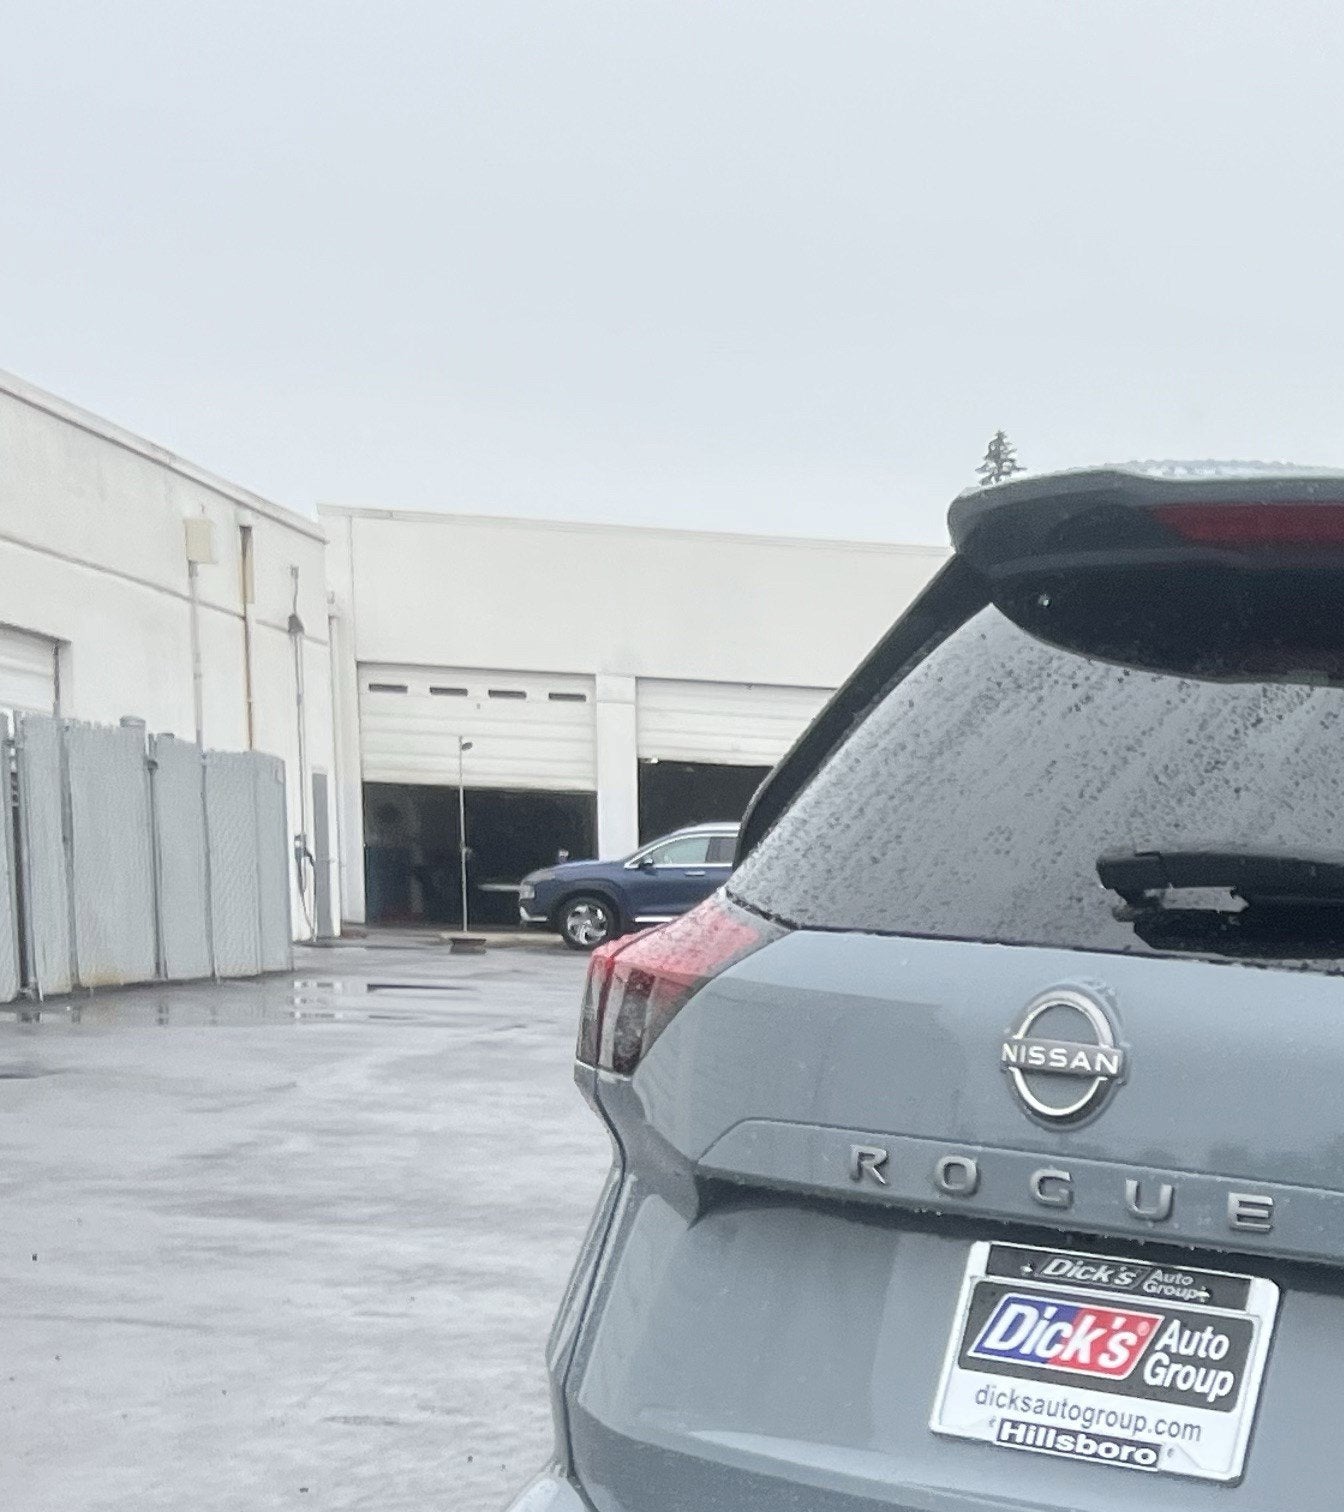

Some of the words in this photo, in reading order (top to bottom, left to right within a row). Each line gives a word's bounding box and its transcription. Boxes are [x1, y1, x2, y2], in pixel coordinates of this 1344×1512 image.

[1001, 1043, 1119, 1074] NISSAN
[850, 1144, 1275, 1233] ROGUE
[1042, 1258, 1137, 1286] Dick's
[1151, 1269, 1194, 1286] Auto
[1143, 1280, 1200, 1301] Group
[983, 1300, 1137, 1369] Dick's
[1155, 1319, 1229, 1361] Auto
[1143, 1352, 1234, 1402] Group
[975, 1384, 1202, 1442] dicksautogroup.com
[999, 1420, 1158, 1466] Hillsboro
